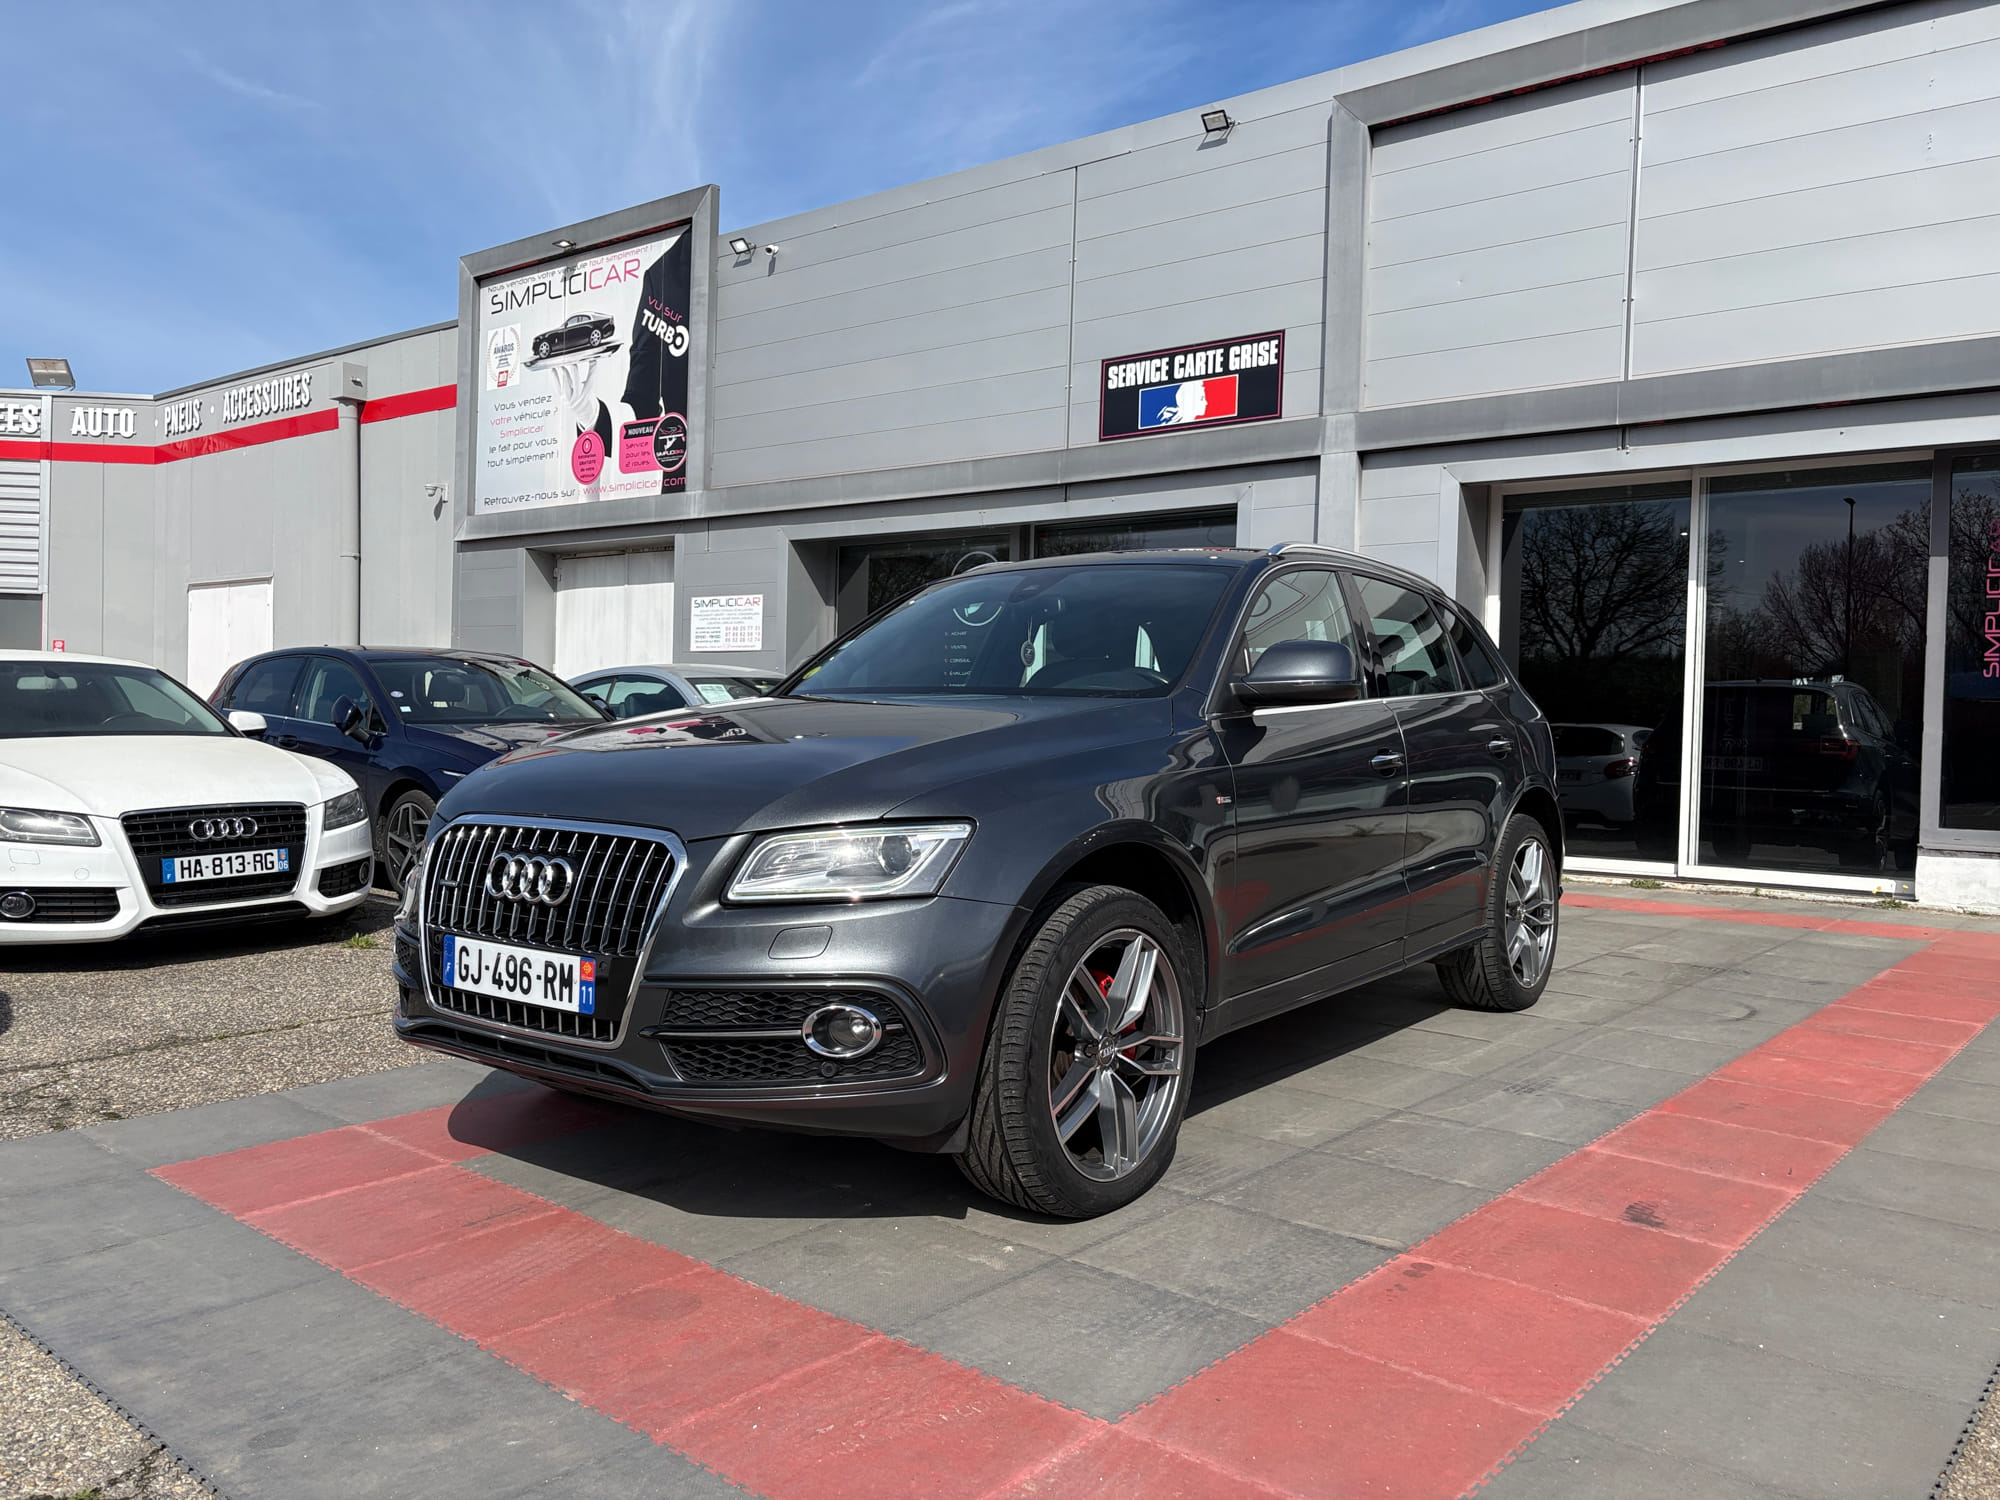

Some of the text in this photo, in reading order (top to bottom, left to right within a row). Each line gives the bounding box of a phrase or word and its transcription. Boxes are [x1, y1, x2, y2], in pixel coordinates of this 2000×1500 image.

[487, 285, 505, 294] Nous
[506, 275, 536, 288] vendons
[537, 270, 557, 280] votre
[589, 257, 605, 267] tout
[605, 246, 649, 263] simplement
[490, 257, 641, 315] SIMPLICICAR
[648, 295, 683, 323] vu sur
[641, 308, 690, 358] TURBO
[1107, 339, 1279, 390] SERVICE CARTE GRISE
[164, 372, 311, 435] PNEUS ACCESSOIRES
[494, 395, 552, 412] Vous vendez
[70, 406, 136, 438] AUTO
[490, 416, 512, 427] votre
[514, 409, 551, 422] véhicule
[500, 425, 545, 439] Simplicicar
[628, 425, 654, 436] NOUVEAU
[487, 458, 504, 468] tout
[505, 450, 555, 466] simplement
[489, 437, 558, 455] le fait pour vous
[483, 490, 559, 507] Retrouvez-nous
[561, 488, 576, 498] sur
[583, 476, 687, 495] www.simplicicar.com
[693, 596, 761, 609] SIMPLICICAR
[180, 852, 275, 879] HA-813-RG
[278, 860, 289, 870] 06
[458, 945, 574, 1004] GJ-496-RM
[581, 985, 593, 1006] 11
